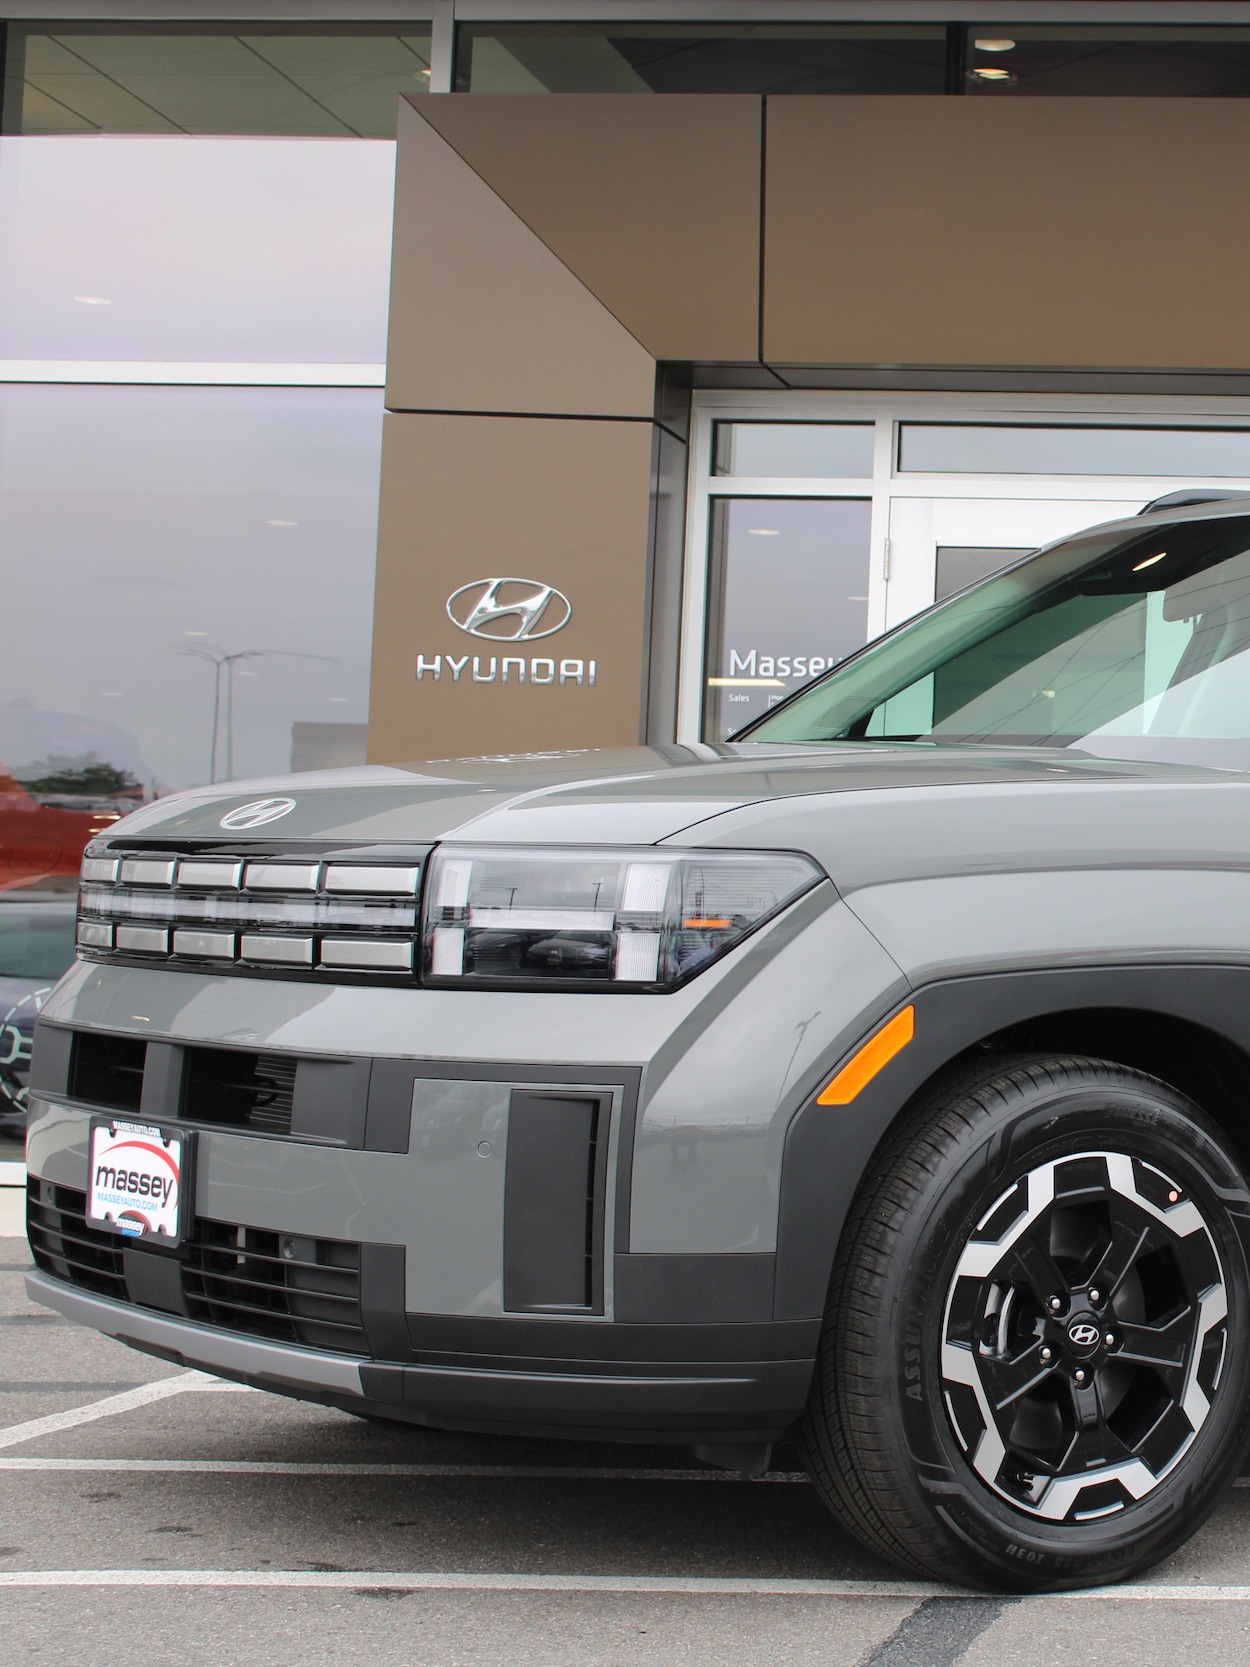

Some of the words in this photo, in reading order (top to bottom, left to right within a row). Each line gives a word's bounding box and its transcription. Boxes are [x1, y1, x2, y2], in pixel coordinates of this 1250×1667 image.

[416, 654, 597, 687] HYUNDAI
[728, 693, 750, 702] Sales
[95, 1165, 173, 1208] massey
[97, 1192, 158, 1211] MASSEYAUTO.COM
